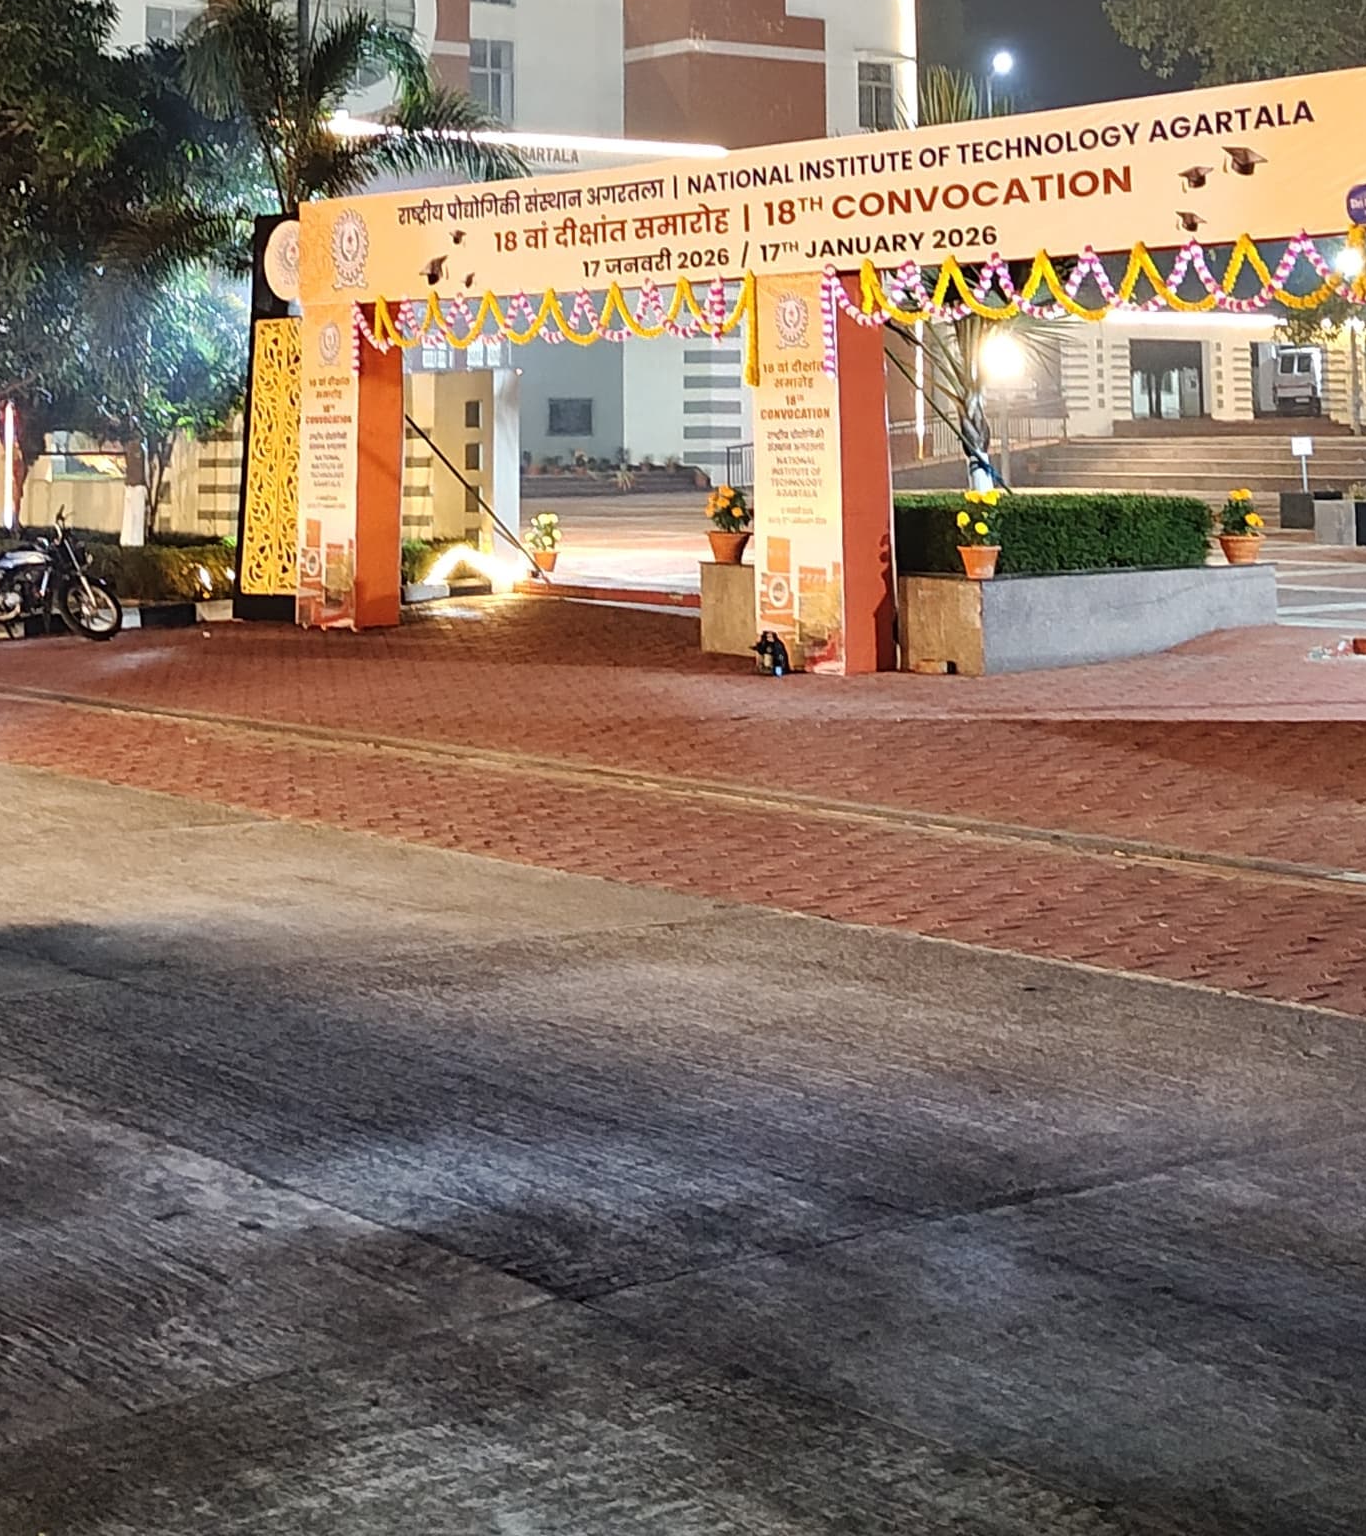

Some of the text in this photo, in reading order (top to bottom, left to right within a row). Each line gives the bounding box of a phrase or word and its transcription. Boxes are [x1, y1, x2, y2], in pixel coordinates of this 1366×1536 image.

[397, 199, 444, 225] राष्ट्रीय
[524, 188, 582, 214] संस्थान
[587, 179, 664, 206] अगरतला
[687, 164, 793, 195] NATIONAL
[799, 150, 913, 182] INSTITUTE
[919, 146, 950, 168] OF
[957, 122, 1140, 164] TECHNOLOGY
[1148, 100, 1315, 143] AGARTALA
[494, 231, 518, 252] 18
[524, 221, 548, 249] वां
[554, 215, 627, 247] दीक्षांत
[634, 203, 730, 239] समारोह
[764, 195, 824, 227] 18TH
[832, 165, 1132, 220] CONVOCATION
[583, 260, 600, 278] 17
[605, 247, 672, 276] जनवरी
[677, 248, 730, 270] 2026
[760, 241, 799, 263] 17TH
[805, 231, 925, 259] JANUARY
[932, 225, 997, 250] 2026
[760, 408, 830, 420] CONVOCATION
